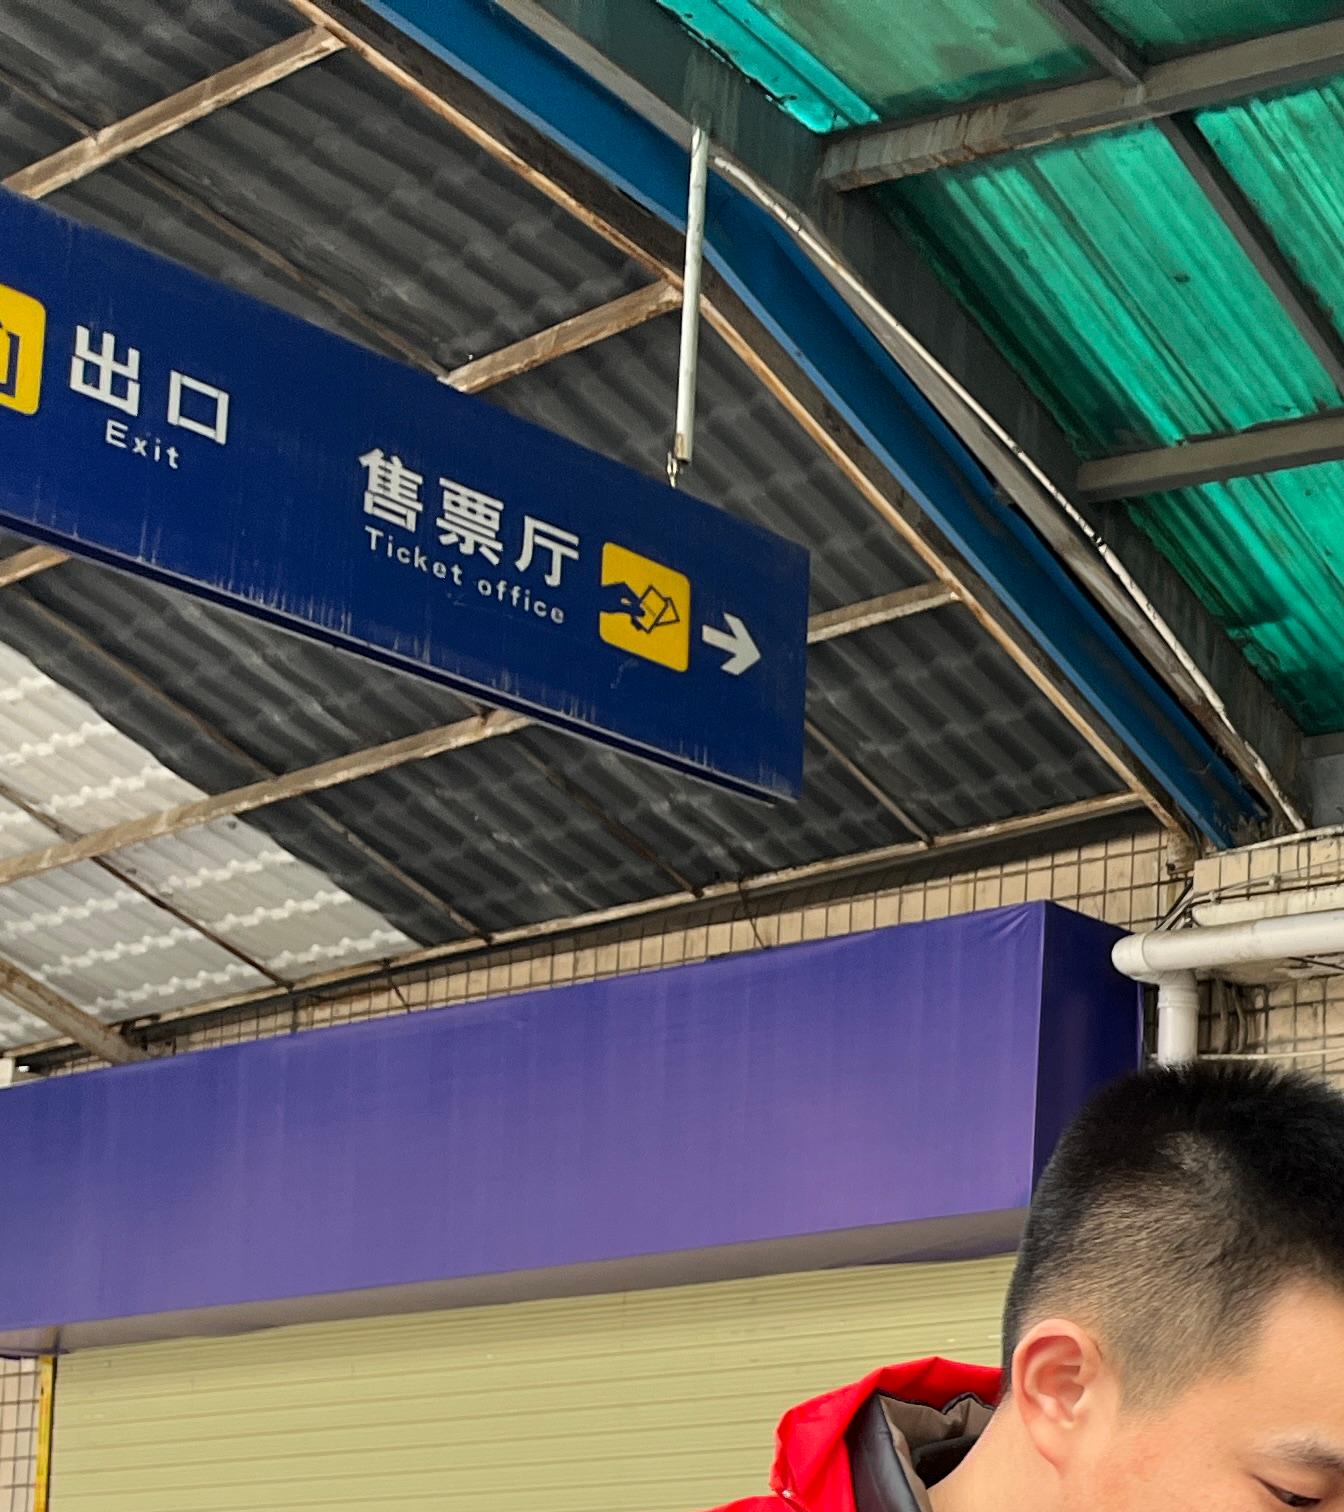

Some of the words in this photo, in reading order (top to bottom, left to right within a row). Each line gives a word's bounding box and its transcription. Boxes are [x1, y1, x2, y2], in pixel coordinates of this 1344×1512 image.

[69, 324, 231, 446] 出口
[104, 418, 182, 470] Exit
[359, 447, 581, 588] 售票厅
[363, 525, 464, 587] Ticket
[477, 576, 567, 624] office
